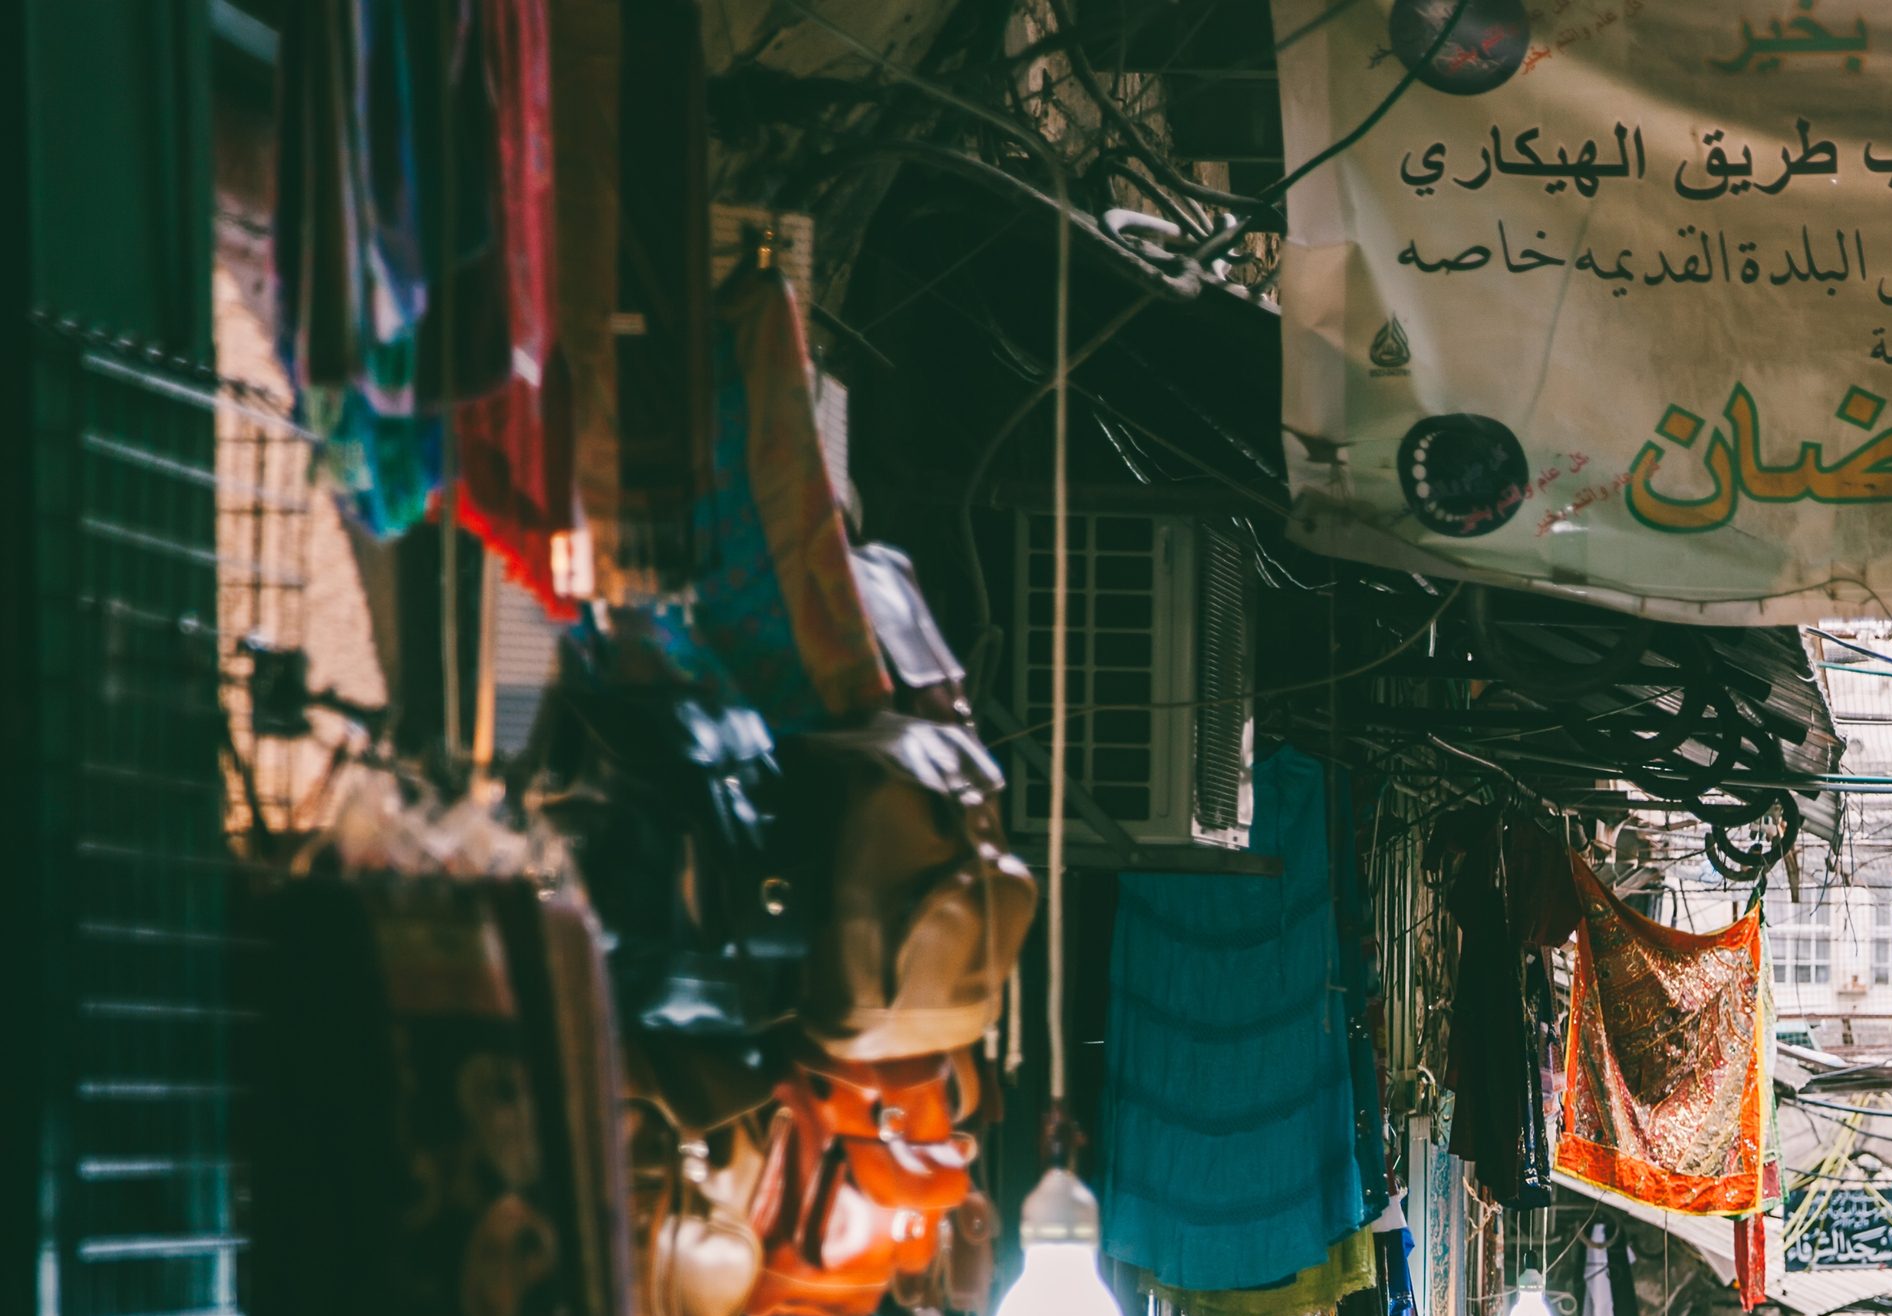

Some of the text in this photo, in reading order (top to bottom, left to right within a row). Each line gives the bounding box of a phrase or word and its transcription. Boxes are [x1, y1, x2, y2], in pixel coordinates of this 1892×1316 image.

[1703, 0, 1869, 75] بخير
[1398, 120, 1647, 199] الهيكاري
[1673, 116, 1838, 202] طريق
[1396, 218, 1567, 276] خاصه
[1574, 224, 1731, 298] القديمه
[1737, 224, 1867, 297] البلدة
